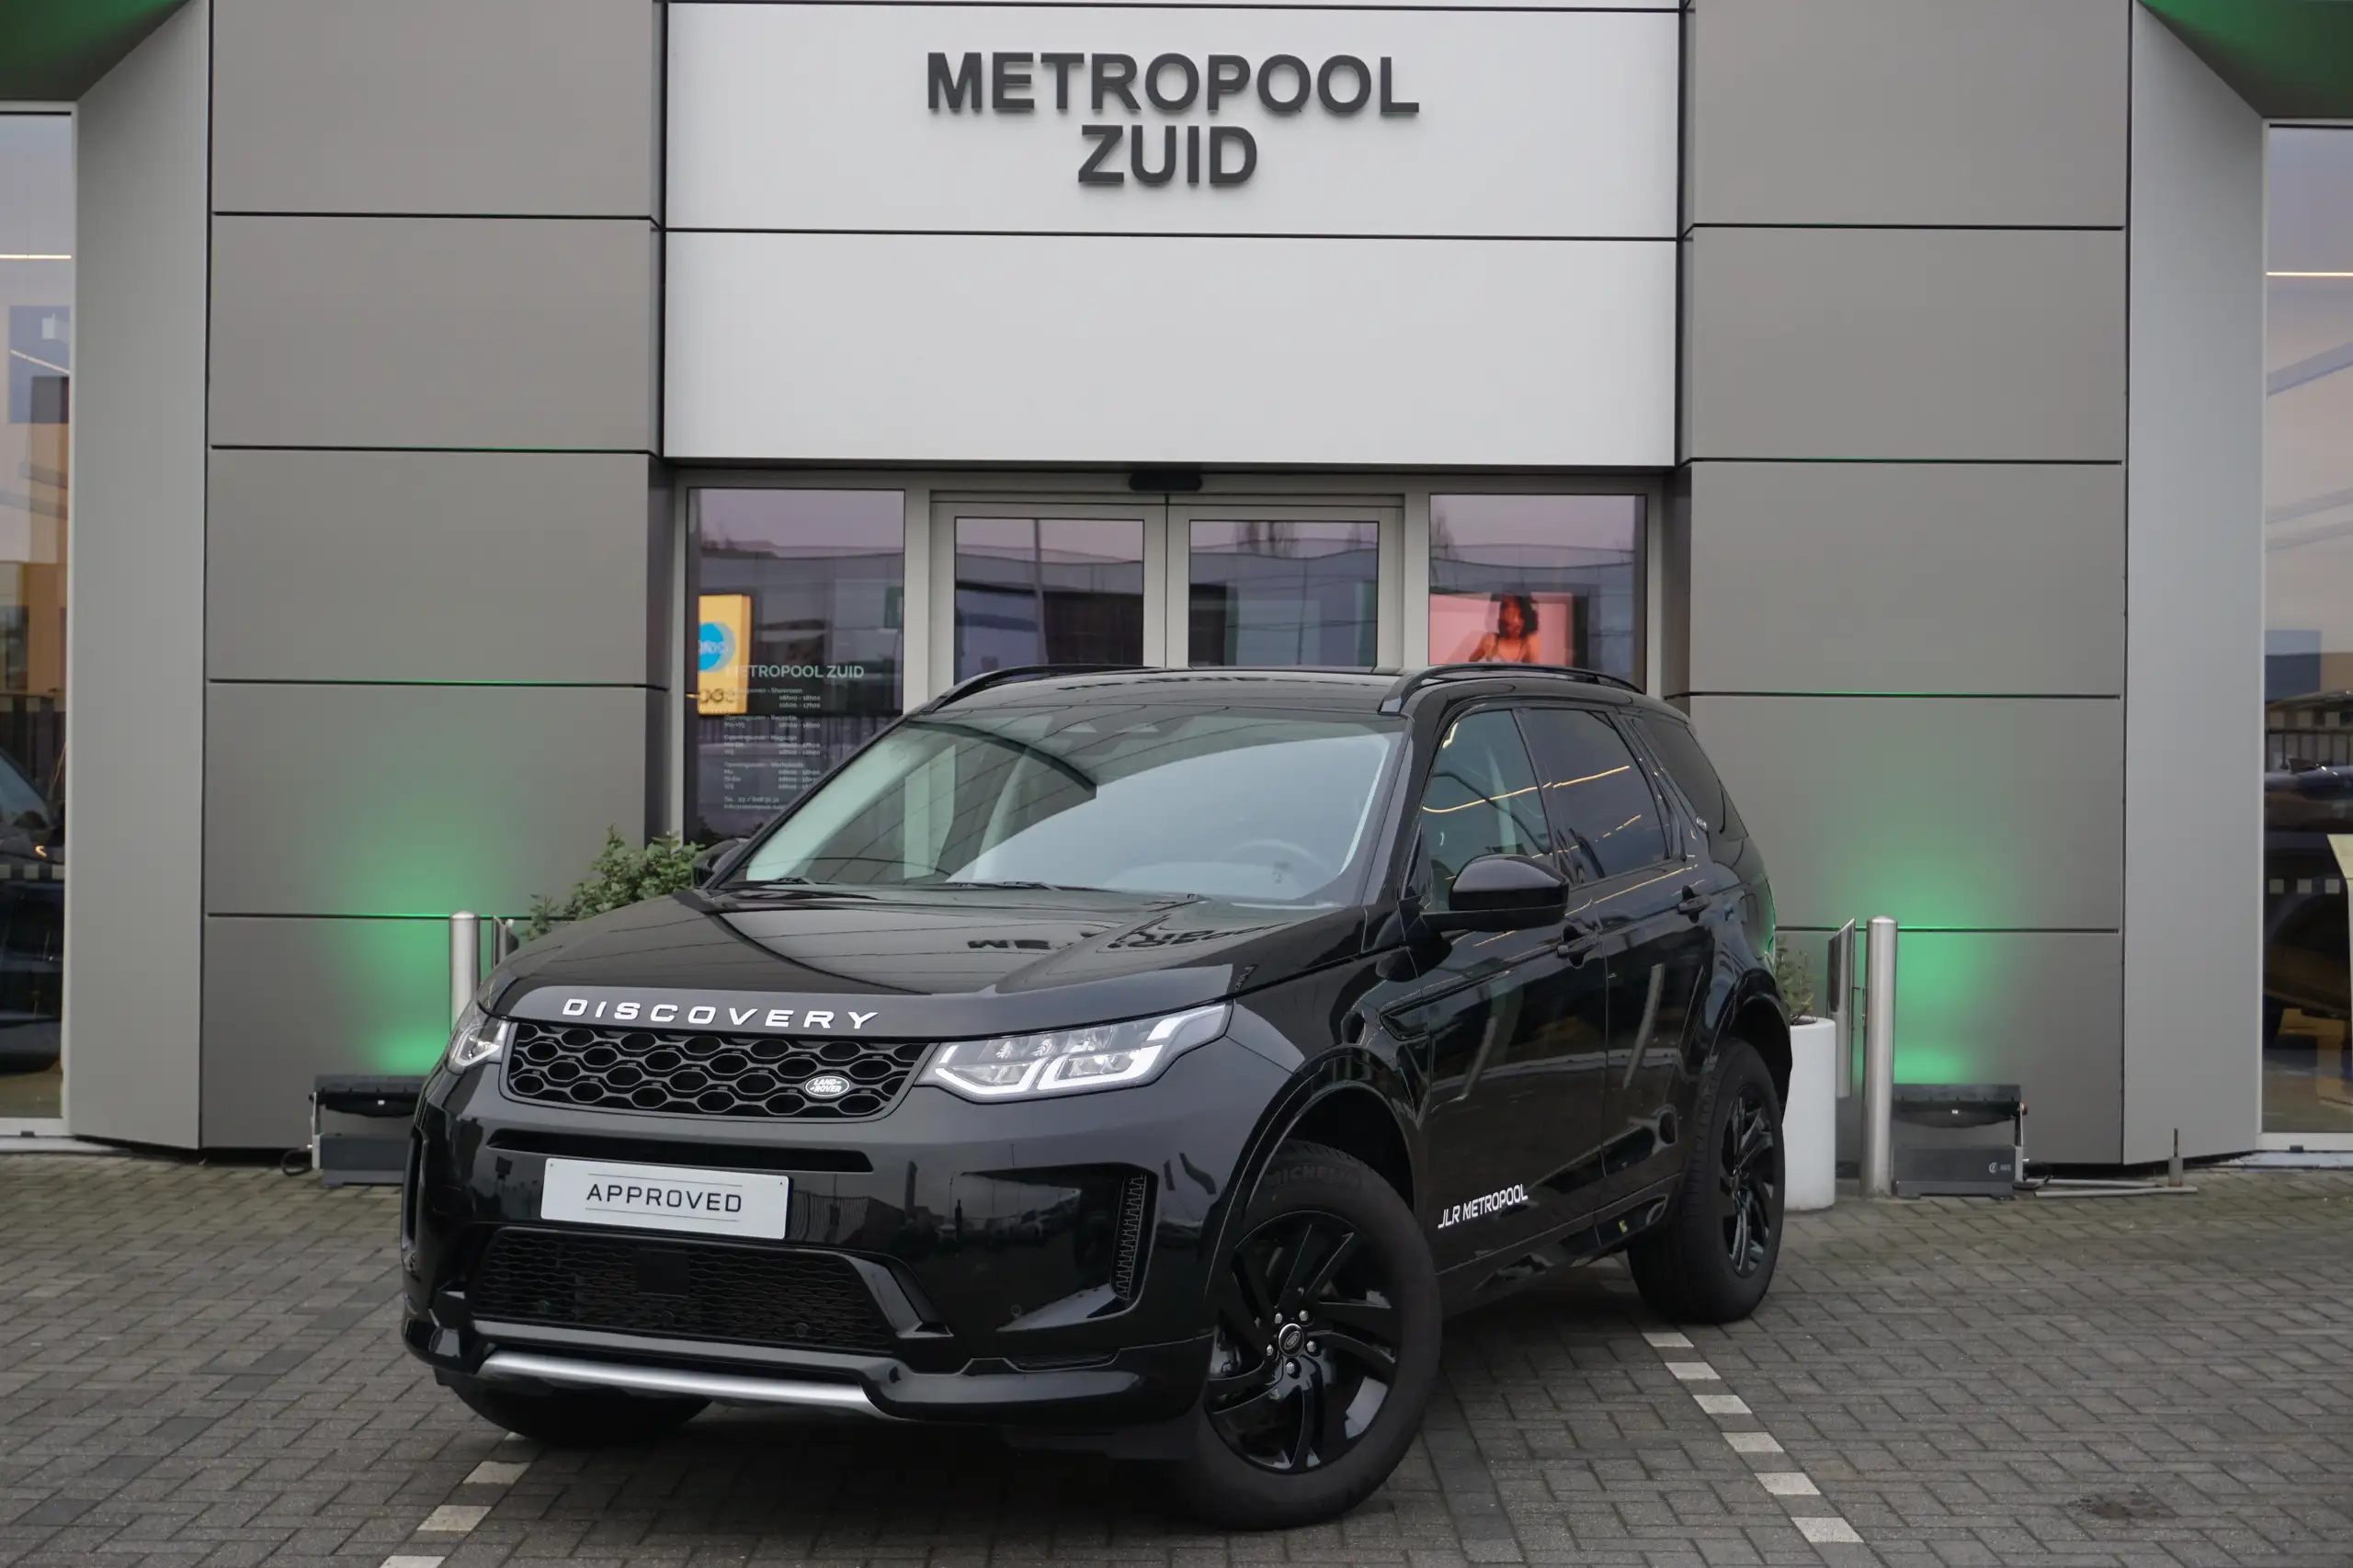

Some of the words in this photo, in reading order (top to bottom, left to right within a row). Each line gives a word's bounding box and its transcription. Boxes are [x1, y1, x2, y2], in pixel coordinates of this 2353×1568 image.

[926, 51, 1420, 114] METROPOOL
[1077, 124, 1258, 184] ZUID
[826, 665, 864, 678] ZUID
[562, 998, 879, 1029] DISCOVERY
[813, 1085, 842, 1093] ROVER
[585, 1183, 743, 1213] APPROVED
[1438, 1205, 1460, 1229] JLR
[1462, 1183, 1528, 1221] METROPOOL
